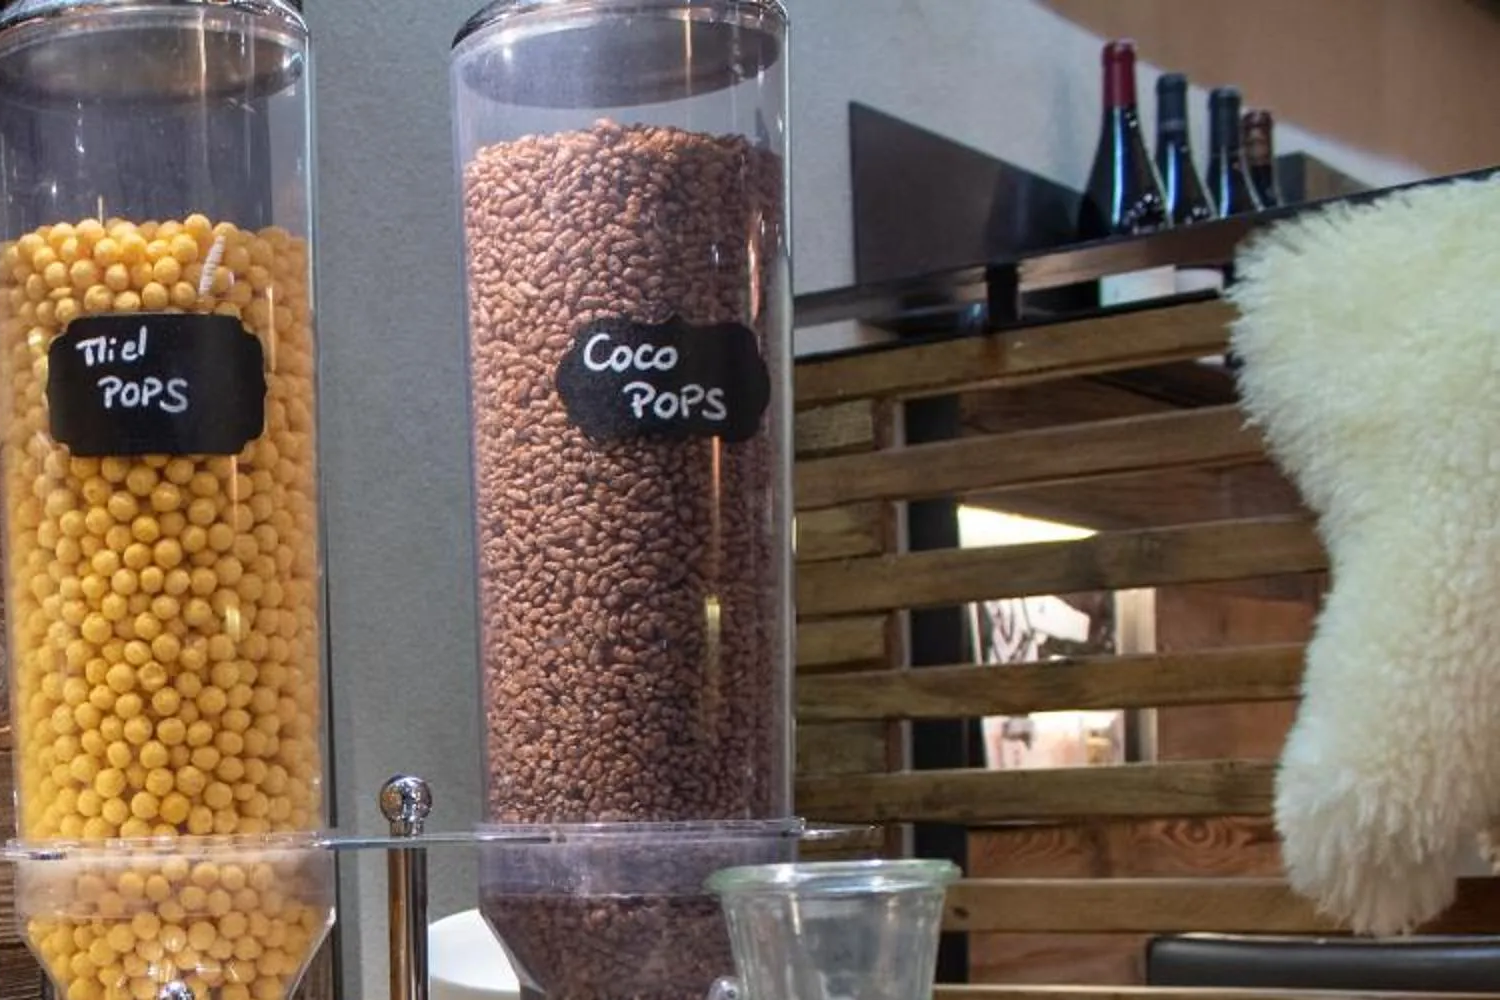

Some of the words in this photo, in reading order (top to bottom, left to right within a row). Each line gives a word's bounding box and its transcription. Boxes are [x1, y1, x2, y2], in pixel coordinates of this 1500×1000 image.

[75, 325, 148, 367] Miel
[583, 332, 679, 373] Coco
[96, 375, 189, 414] POPS
[621, 380, 728, 422] POPS
